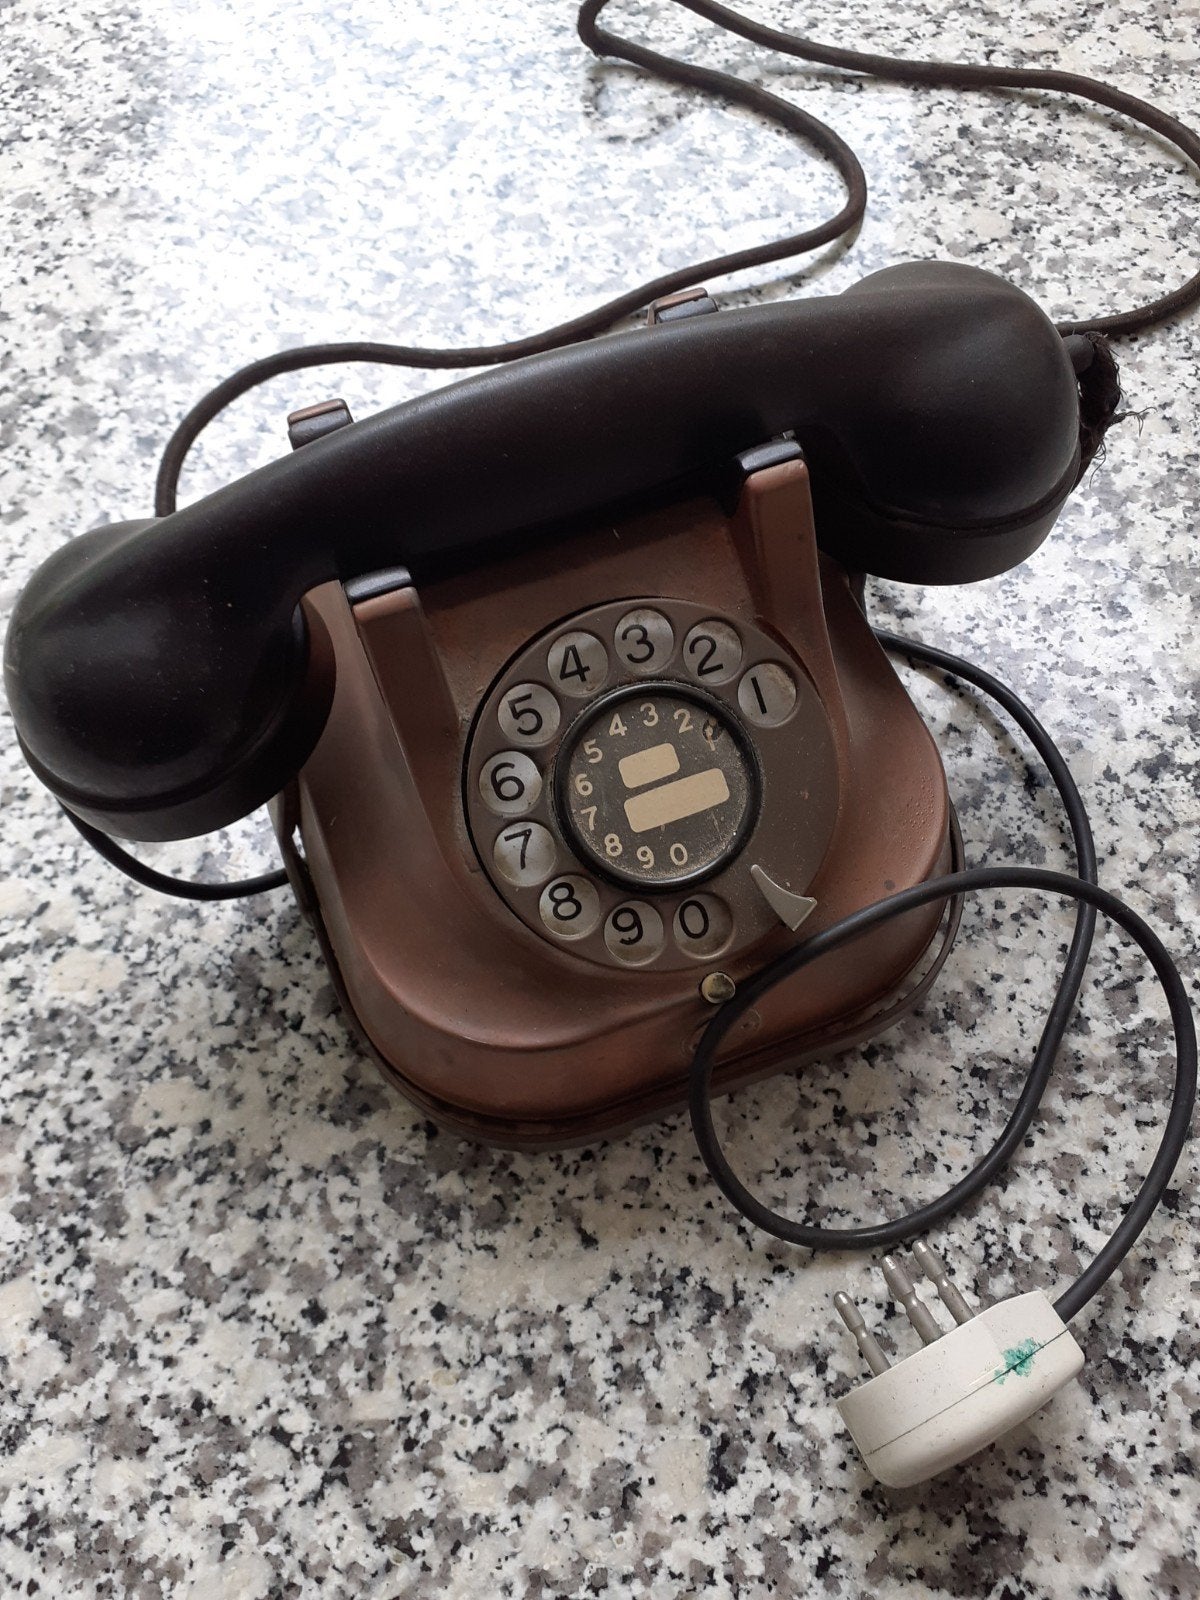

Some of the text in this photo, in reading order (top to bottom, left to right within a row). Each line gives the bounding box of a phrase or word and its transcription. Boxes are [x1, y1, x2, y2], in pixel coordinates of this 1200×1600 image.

[622, 624, 654, 663] 3
[689, 635, 723, 676] 2
[559, 645, 590, 682] 4
[751, 677, 767, 714] 1
[508, 694, 543, 736] 5
[609, 713, 627, 736] 4
[640, 703, 658, 726] 3
[674, 709, 693, 733] 2
[584, 739, 603, 763] 5
[491, 762, 524, 801] 6
[576, 774, 593, 795] 6
[581, 806, 597, 830] 7
[504, 829, 532, 869] 7
[605, 834, 622, 856] 8
[637, 846, 654, 868] 9
[670, 844, 688, 865] 0
[548, 882, 581, 920] 8
[679, 900, 708, 938] 0
[612, 908, 643, 945] 9
